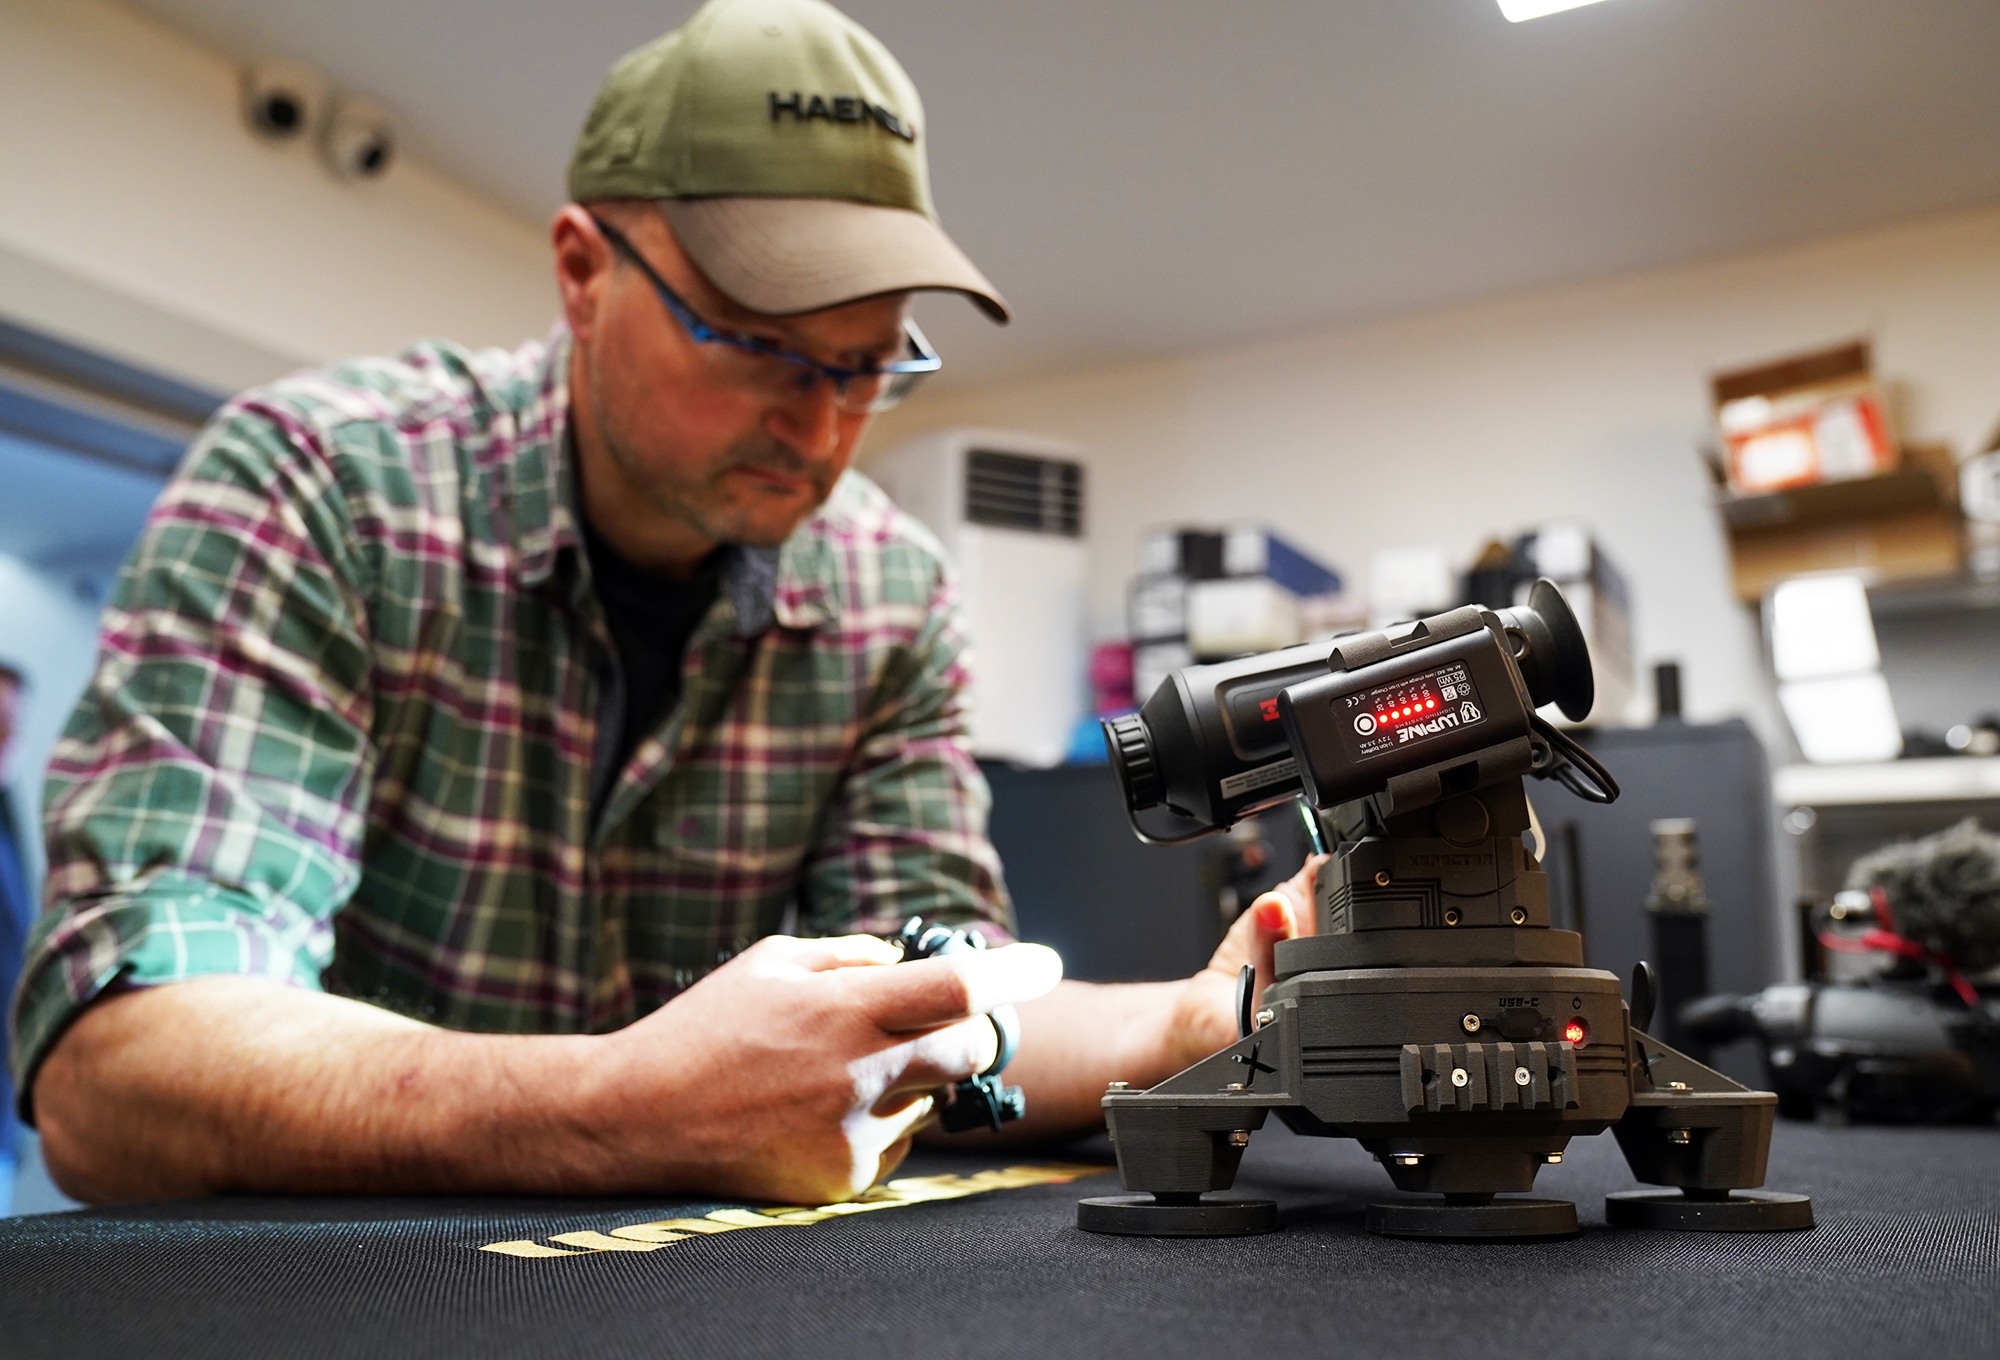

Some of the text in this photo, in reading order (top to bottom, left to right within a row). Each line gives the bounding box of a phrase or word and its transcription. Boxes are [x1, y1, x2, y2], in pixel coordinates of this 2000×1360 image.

[1438, 670, 1466, 687] 25 Wh
[1394, 706, 1455, 729] LIGHTING SYSTEMS
[1396, 712, 1460, 743] LUPINE
[1361, 745, 1380, 755] battery
[1498, 997, 1539, 1008] USB-C
